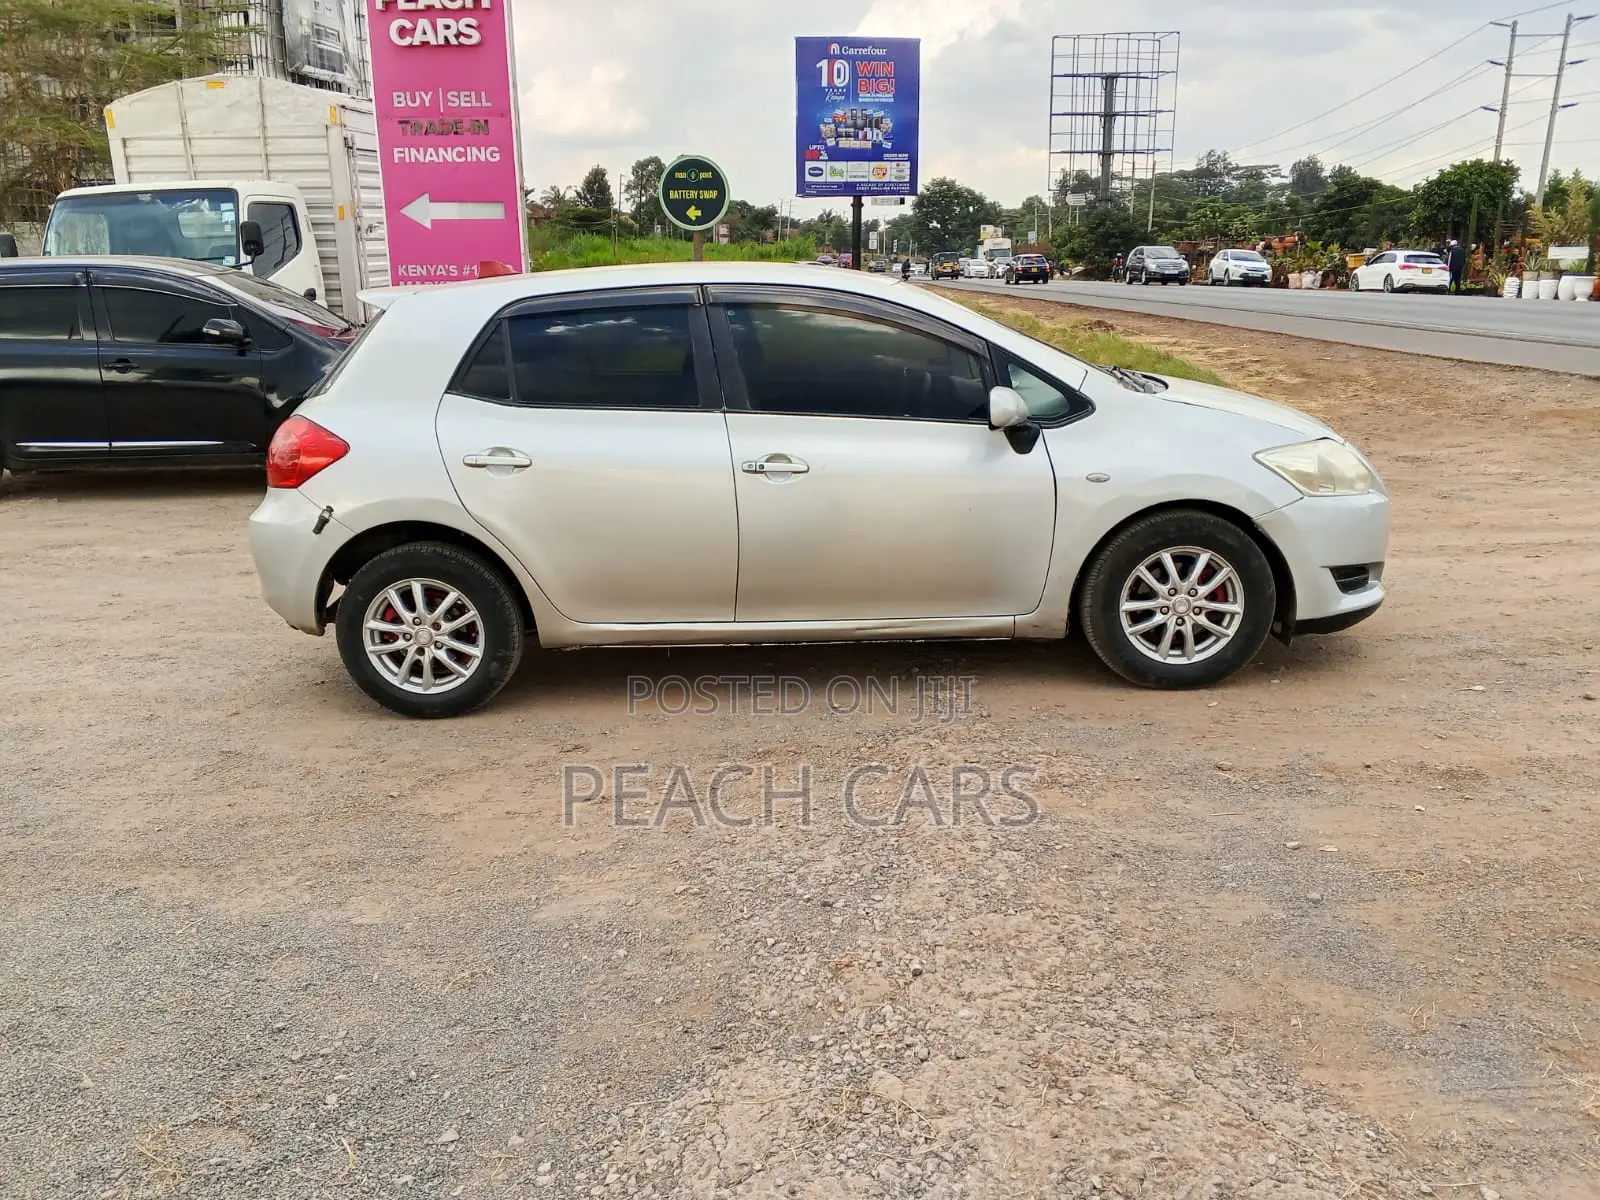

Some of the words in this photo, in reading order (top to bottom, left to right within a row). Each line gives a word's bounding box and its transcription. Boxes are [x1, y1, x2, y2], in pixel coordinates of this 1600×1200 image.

[389, 17, 481, 46] CARS
[842, 45, 887, 55] Carrefour
[816, 58, 850, 88] 10
[856, 61, 894, 77] WIN
[857, 79, 896, 94] BIG!
[392, 91, 433, 108] BUY
[447, 91, 492, 107] SELL
[397, 119, 490, 136] TRADE-IN
[393, 146, 501, 163] FINANCING
[669, 189, 698, 200] BATTERY
[699, 189, 719, 200] SWAP
[398, 264, 458, 277] KENYA'S
[462, 264, 479, 277] #1
